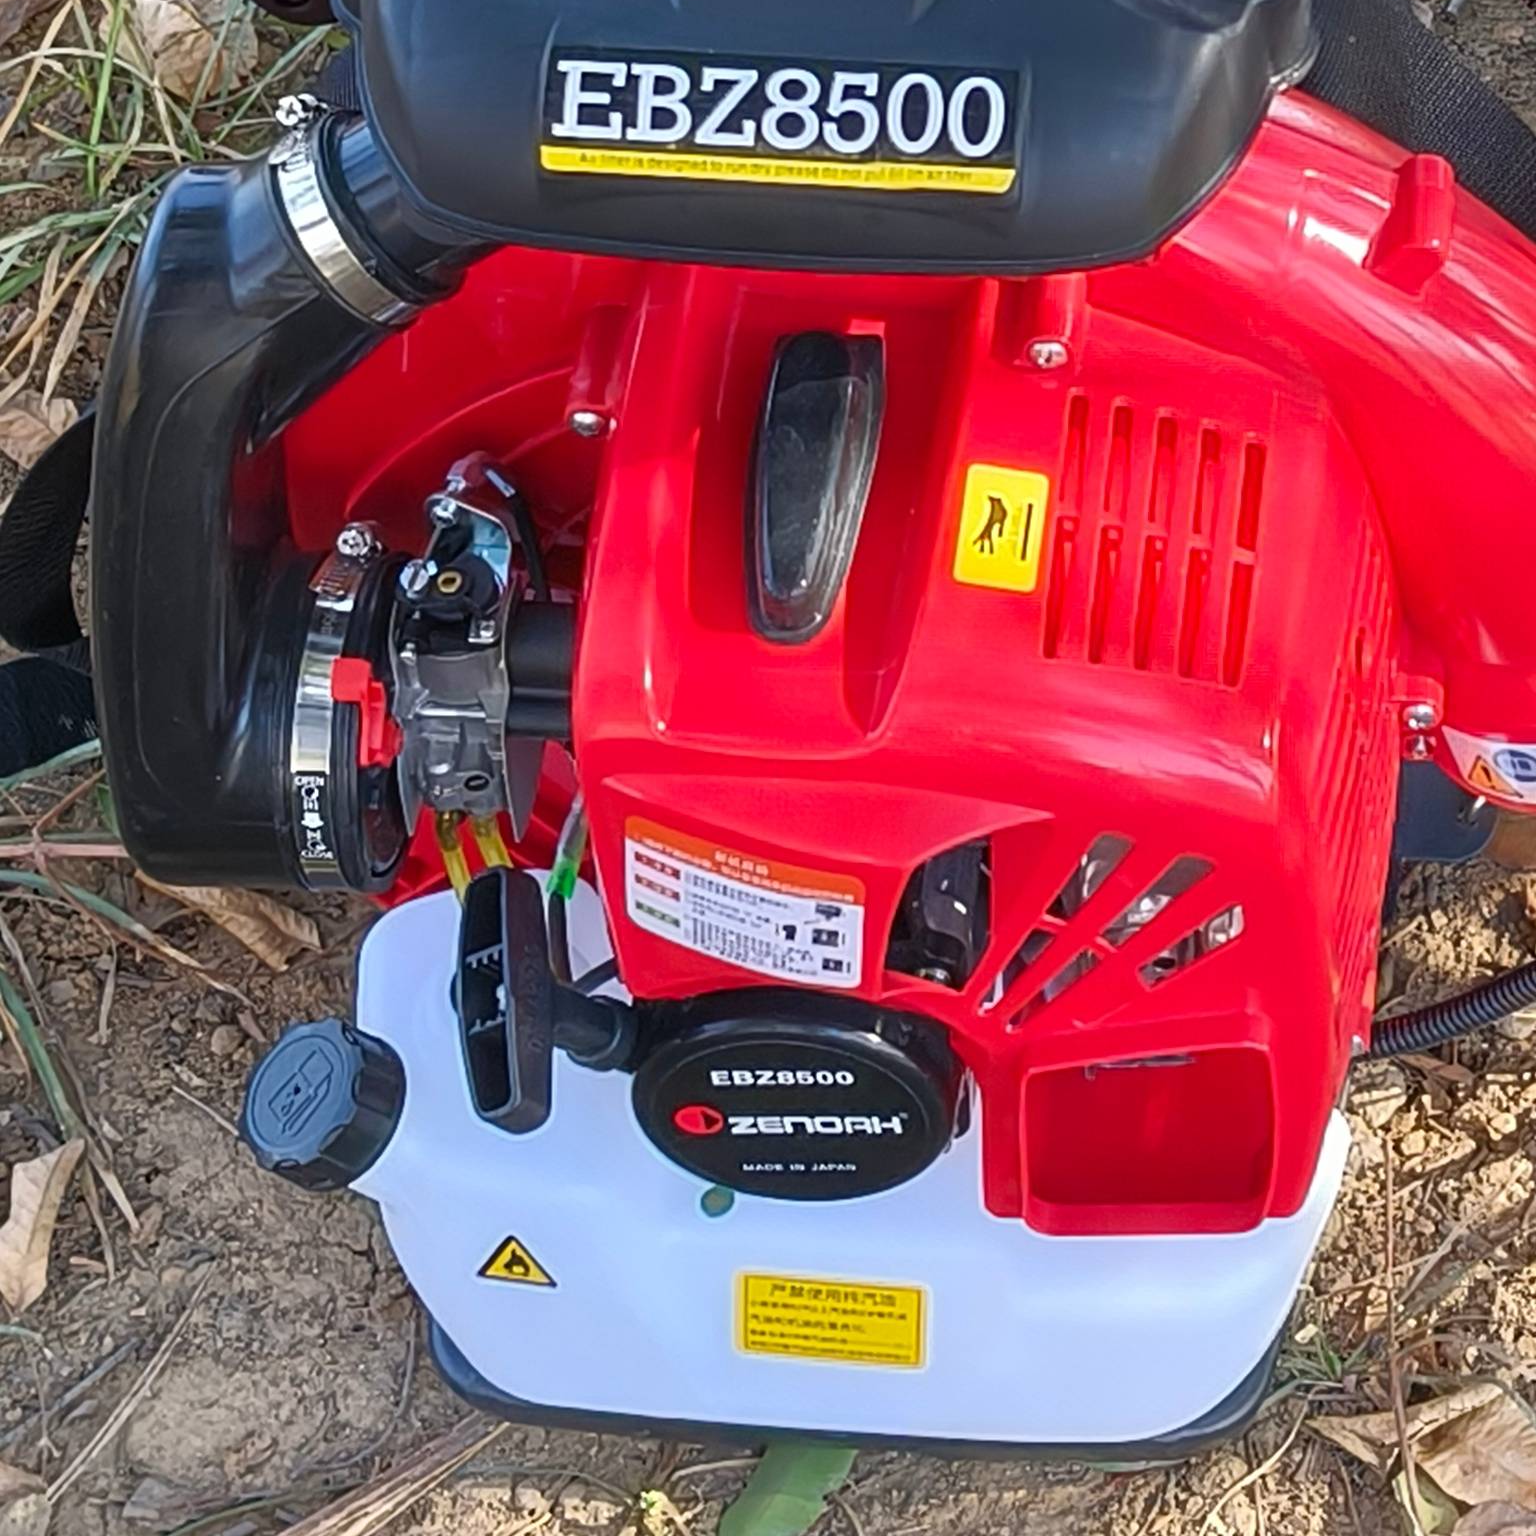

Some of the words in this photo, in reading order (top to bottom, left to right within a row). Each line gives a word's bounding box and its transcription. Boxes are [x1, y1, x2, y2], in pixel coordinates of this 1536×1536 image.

[550, 59, 1006, 158] EBZ8500
[294, 775, 325, 787] OPEN
[709, 1069, 855, 1087] EBZ8500
[727, 1115, 904, 1136] ZENOAH
[743, 1163, 785, 1172] MADE
[789, 1163, 806, 1172] IN
[811, 1163, 857, 1172] JAPAN
